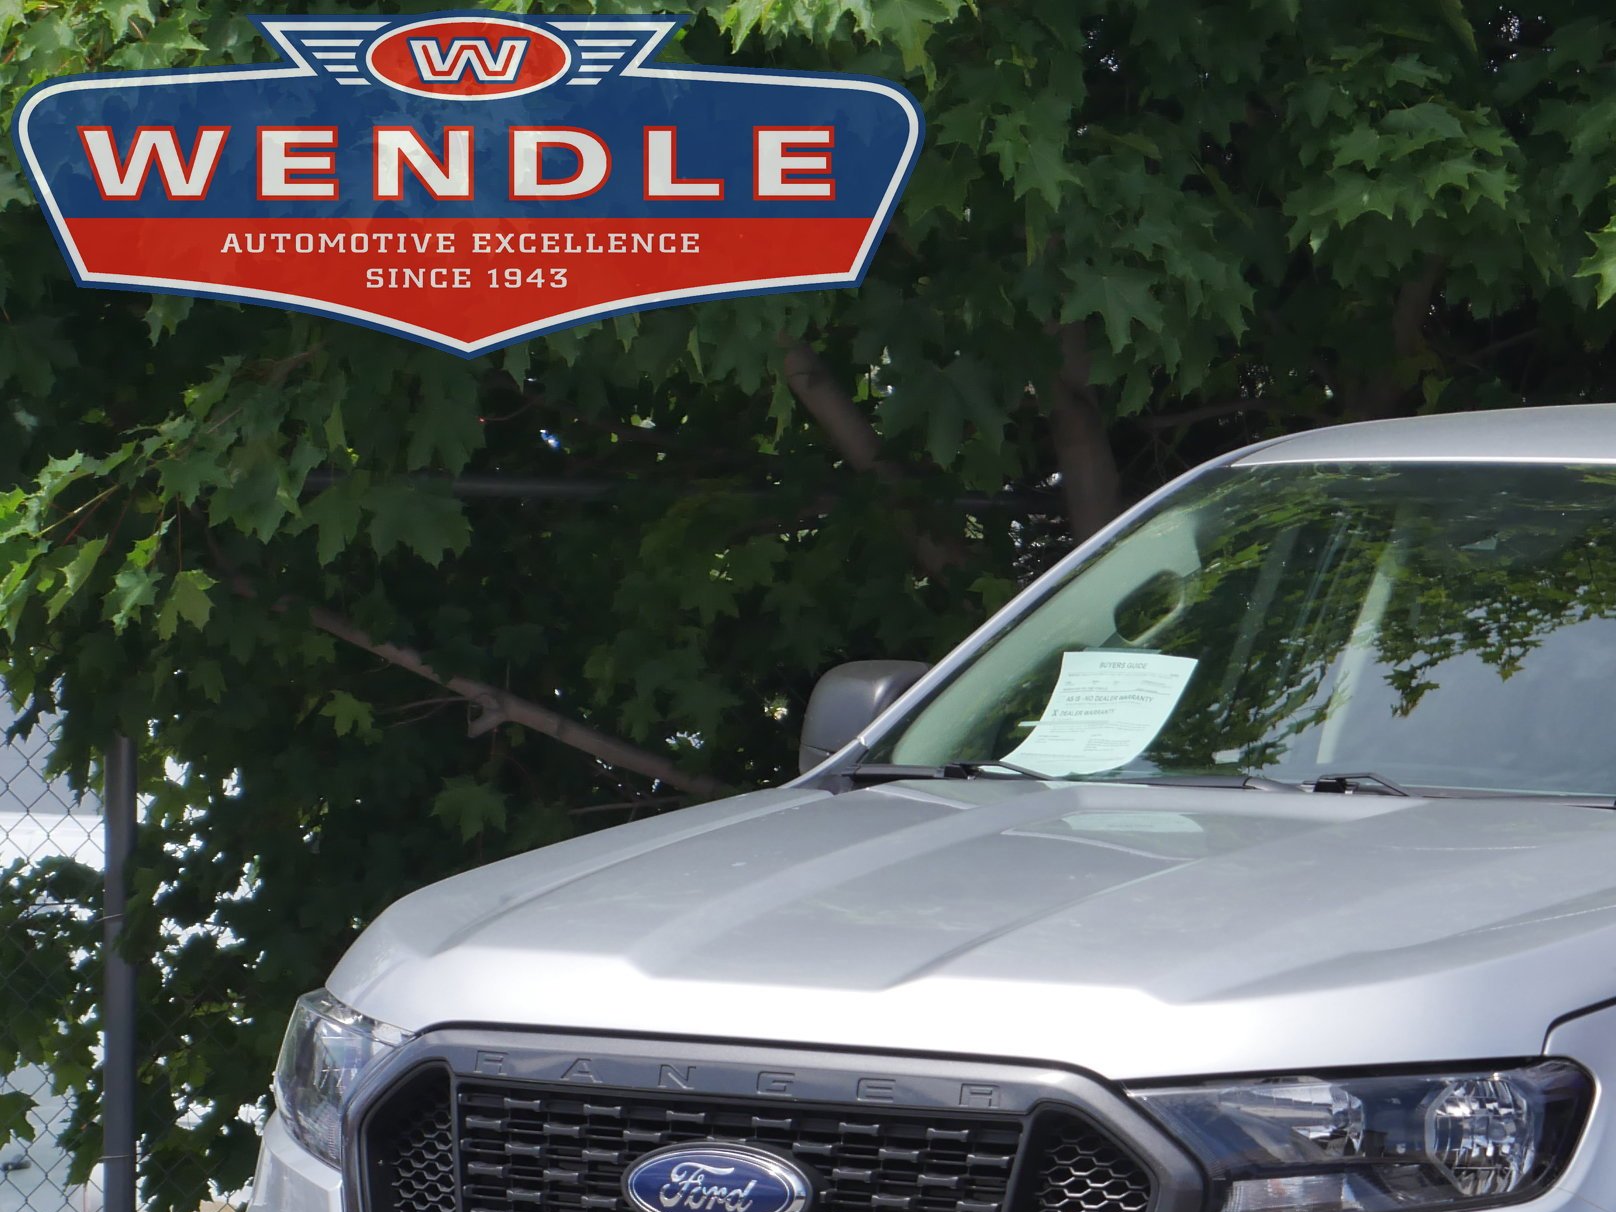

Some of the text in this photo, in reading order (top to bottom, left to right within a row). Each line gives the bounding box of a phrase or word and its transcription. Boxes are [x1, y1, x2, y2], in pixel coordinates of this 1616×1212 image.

[1099, 661, 1148, 670] BUYERS GUIDE
[474, 1050, 1000, 1109] RANGER
